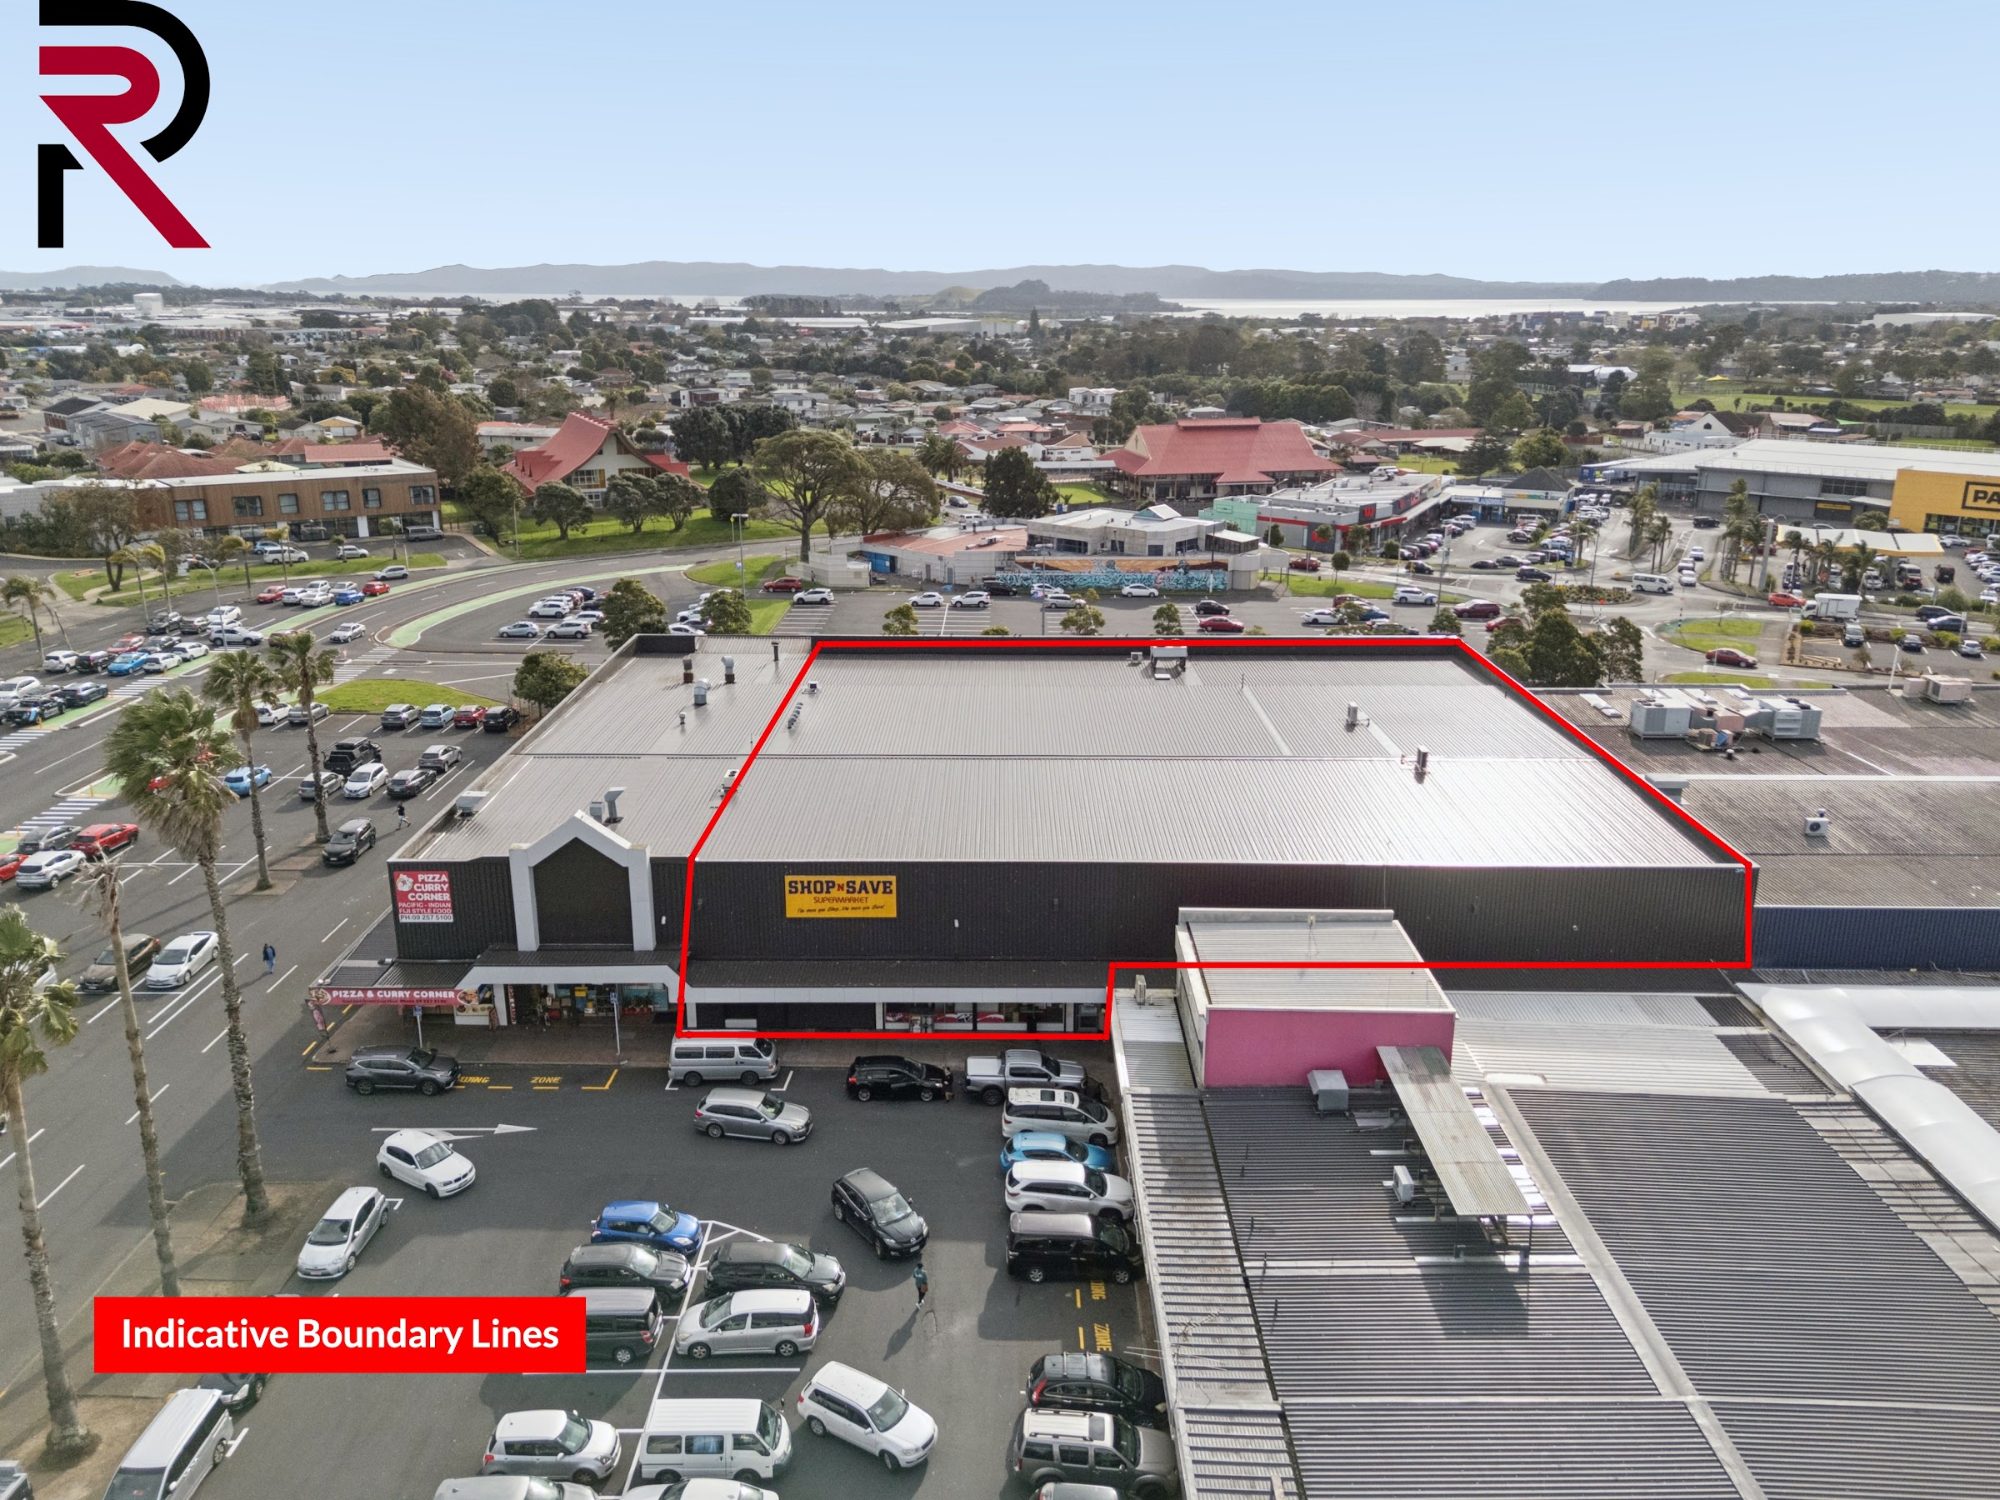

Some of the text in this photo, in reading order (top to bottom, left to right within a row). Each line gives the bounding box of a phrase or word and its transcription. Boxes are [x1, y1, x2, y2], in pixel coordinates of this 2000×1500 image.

[417, 874, 448, 882] PIZZA
[413, 883, 449, 892] CURRY
[788, 880, 835, 894] SHOP
[846, 880, 893, 894] SAVE
[407, 892, 451, 901] CORNER
[813, 896, 868, 904] SUPERMARKET
[332, 990, 364, 998] PIZZA
[377, 990, 410, 998] CURRY
[412, 991, 455, 999] CORNER
[530, 1076, 562, 1084] ZONE
